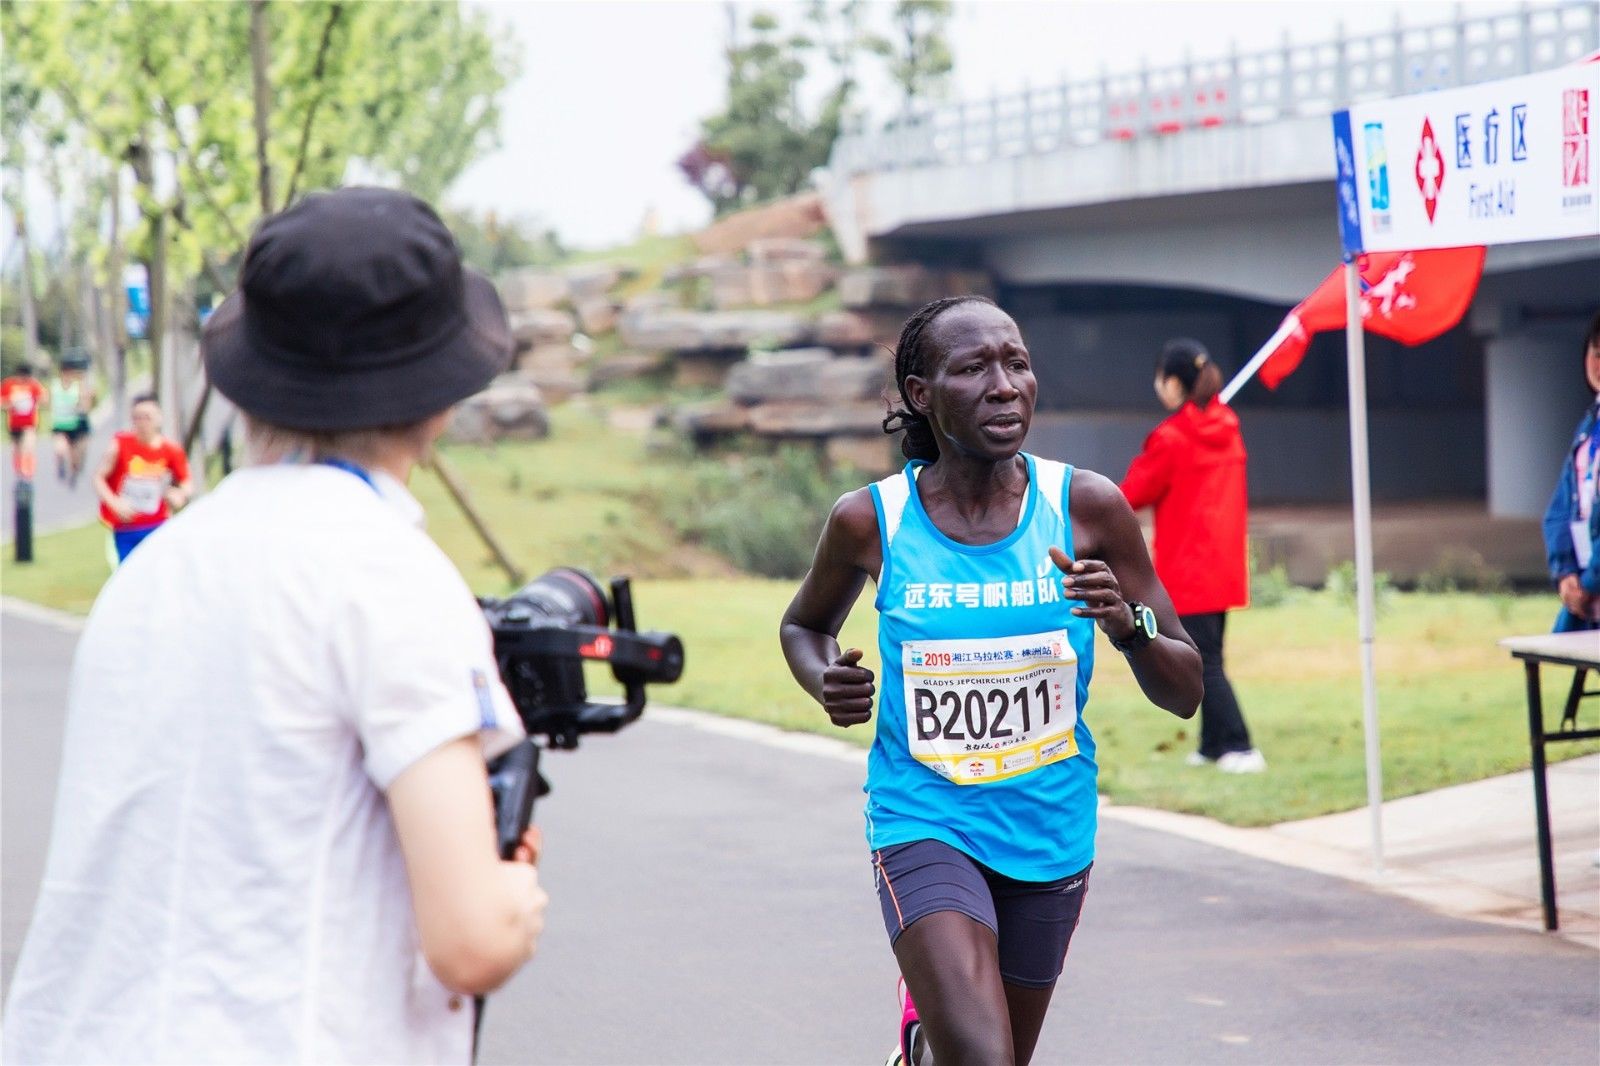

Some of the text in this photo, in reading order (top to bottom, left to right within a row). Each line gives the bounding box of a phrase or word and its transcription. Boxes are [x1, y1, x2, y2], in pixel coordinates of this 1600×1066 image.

[1456, 103, 1527, 169] 医疗区
[1469, 179, 1516, 219] First Aid
[903, 575, 1060, 609] 远东号帆船队
[923, 668, 1057, 687] GLADYS JEPCHIRCHIR CHERUIYOT
[924, 653, 951, 667] 2019
[914, 679, 1052, 741] B20211
